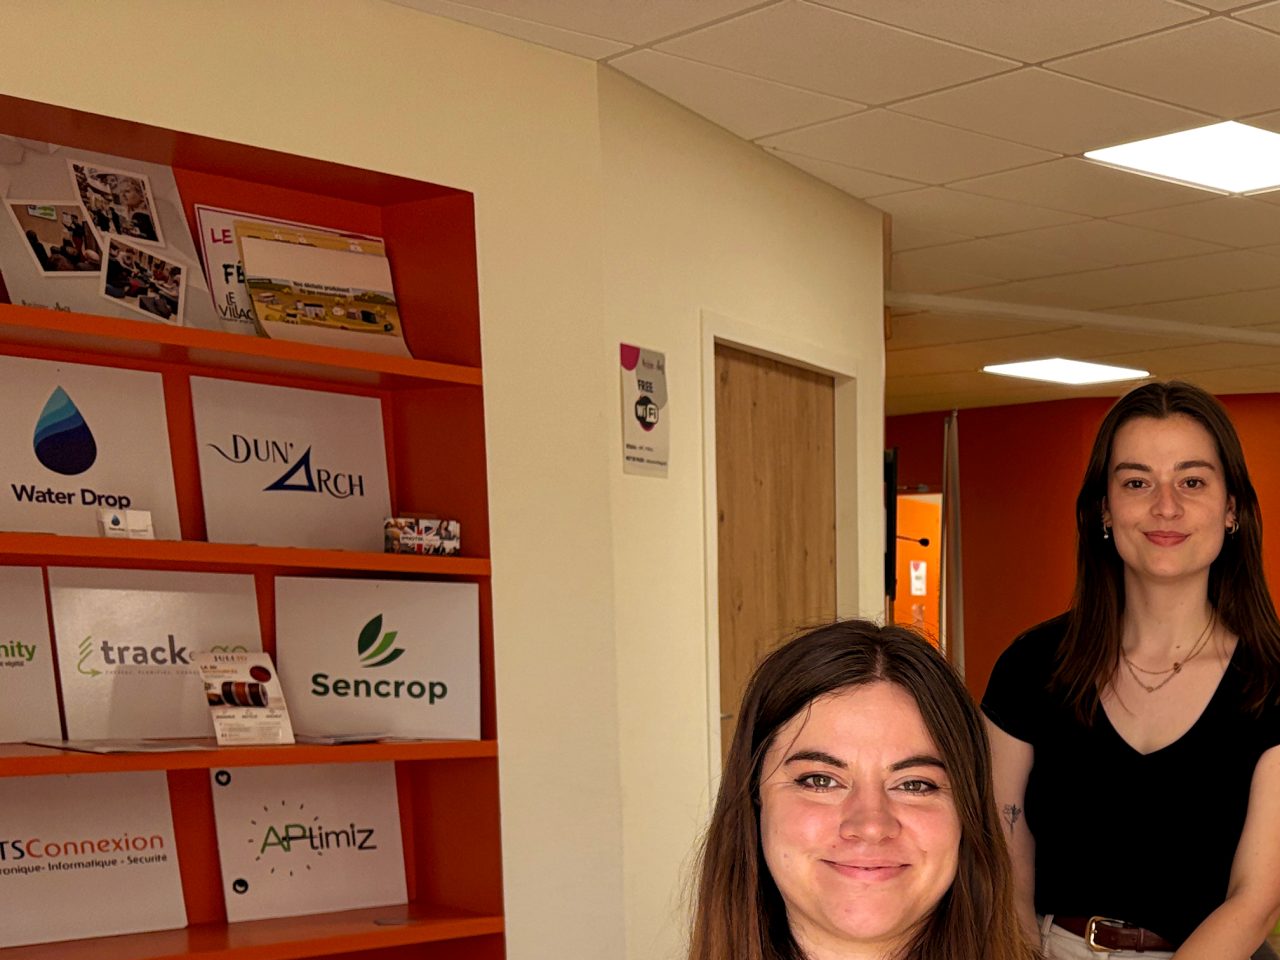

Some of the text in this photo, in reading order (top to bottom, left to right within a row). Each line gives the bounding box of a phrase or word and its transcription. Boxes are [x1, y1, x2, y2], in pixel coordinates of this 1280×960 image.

[210, 228, 233, 243] LE
[637, 379, 654, 393] FREE
[262, 445, 365, 499] ARCH
[11, 484, 131, 510] Water Drop
[311, 673, 448, 705] Sencrop
[0, 833, 164, 861] TSConnexion
[48, 858, 117, 873] Informatique
